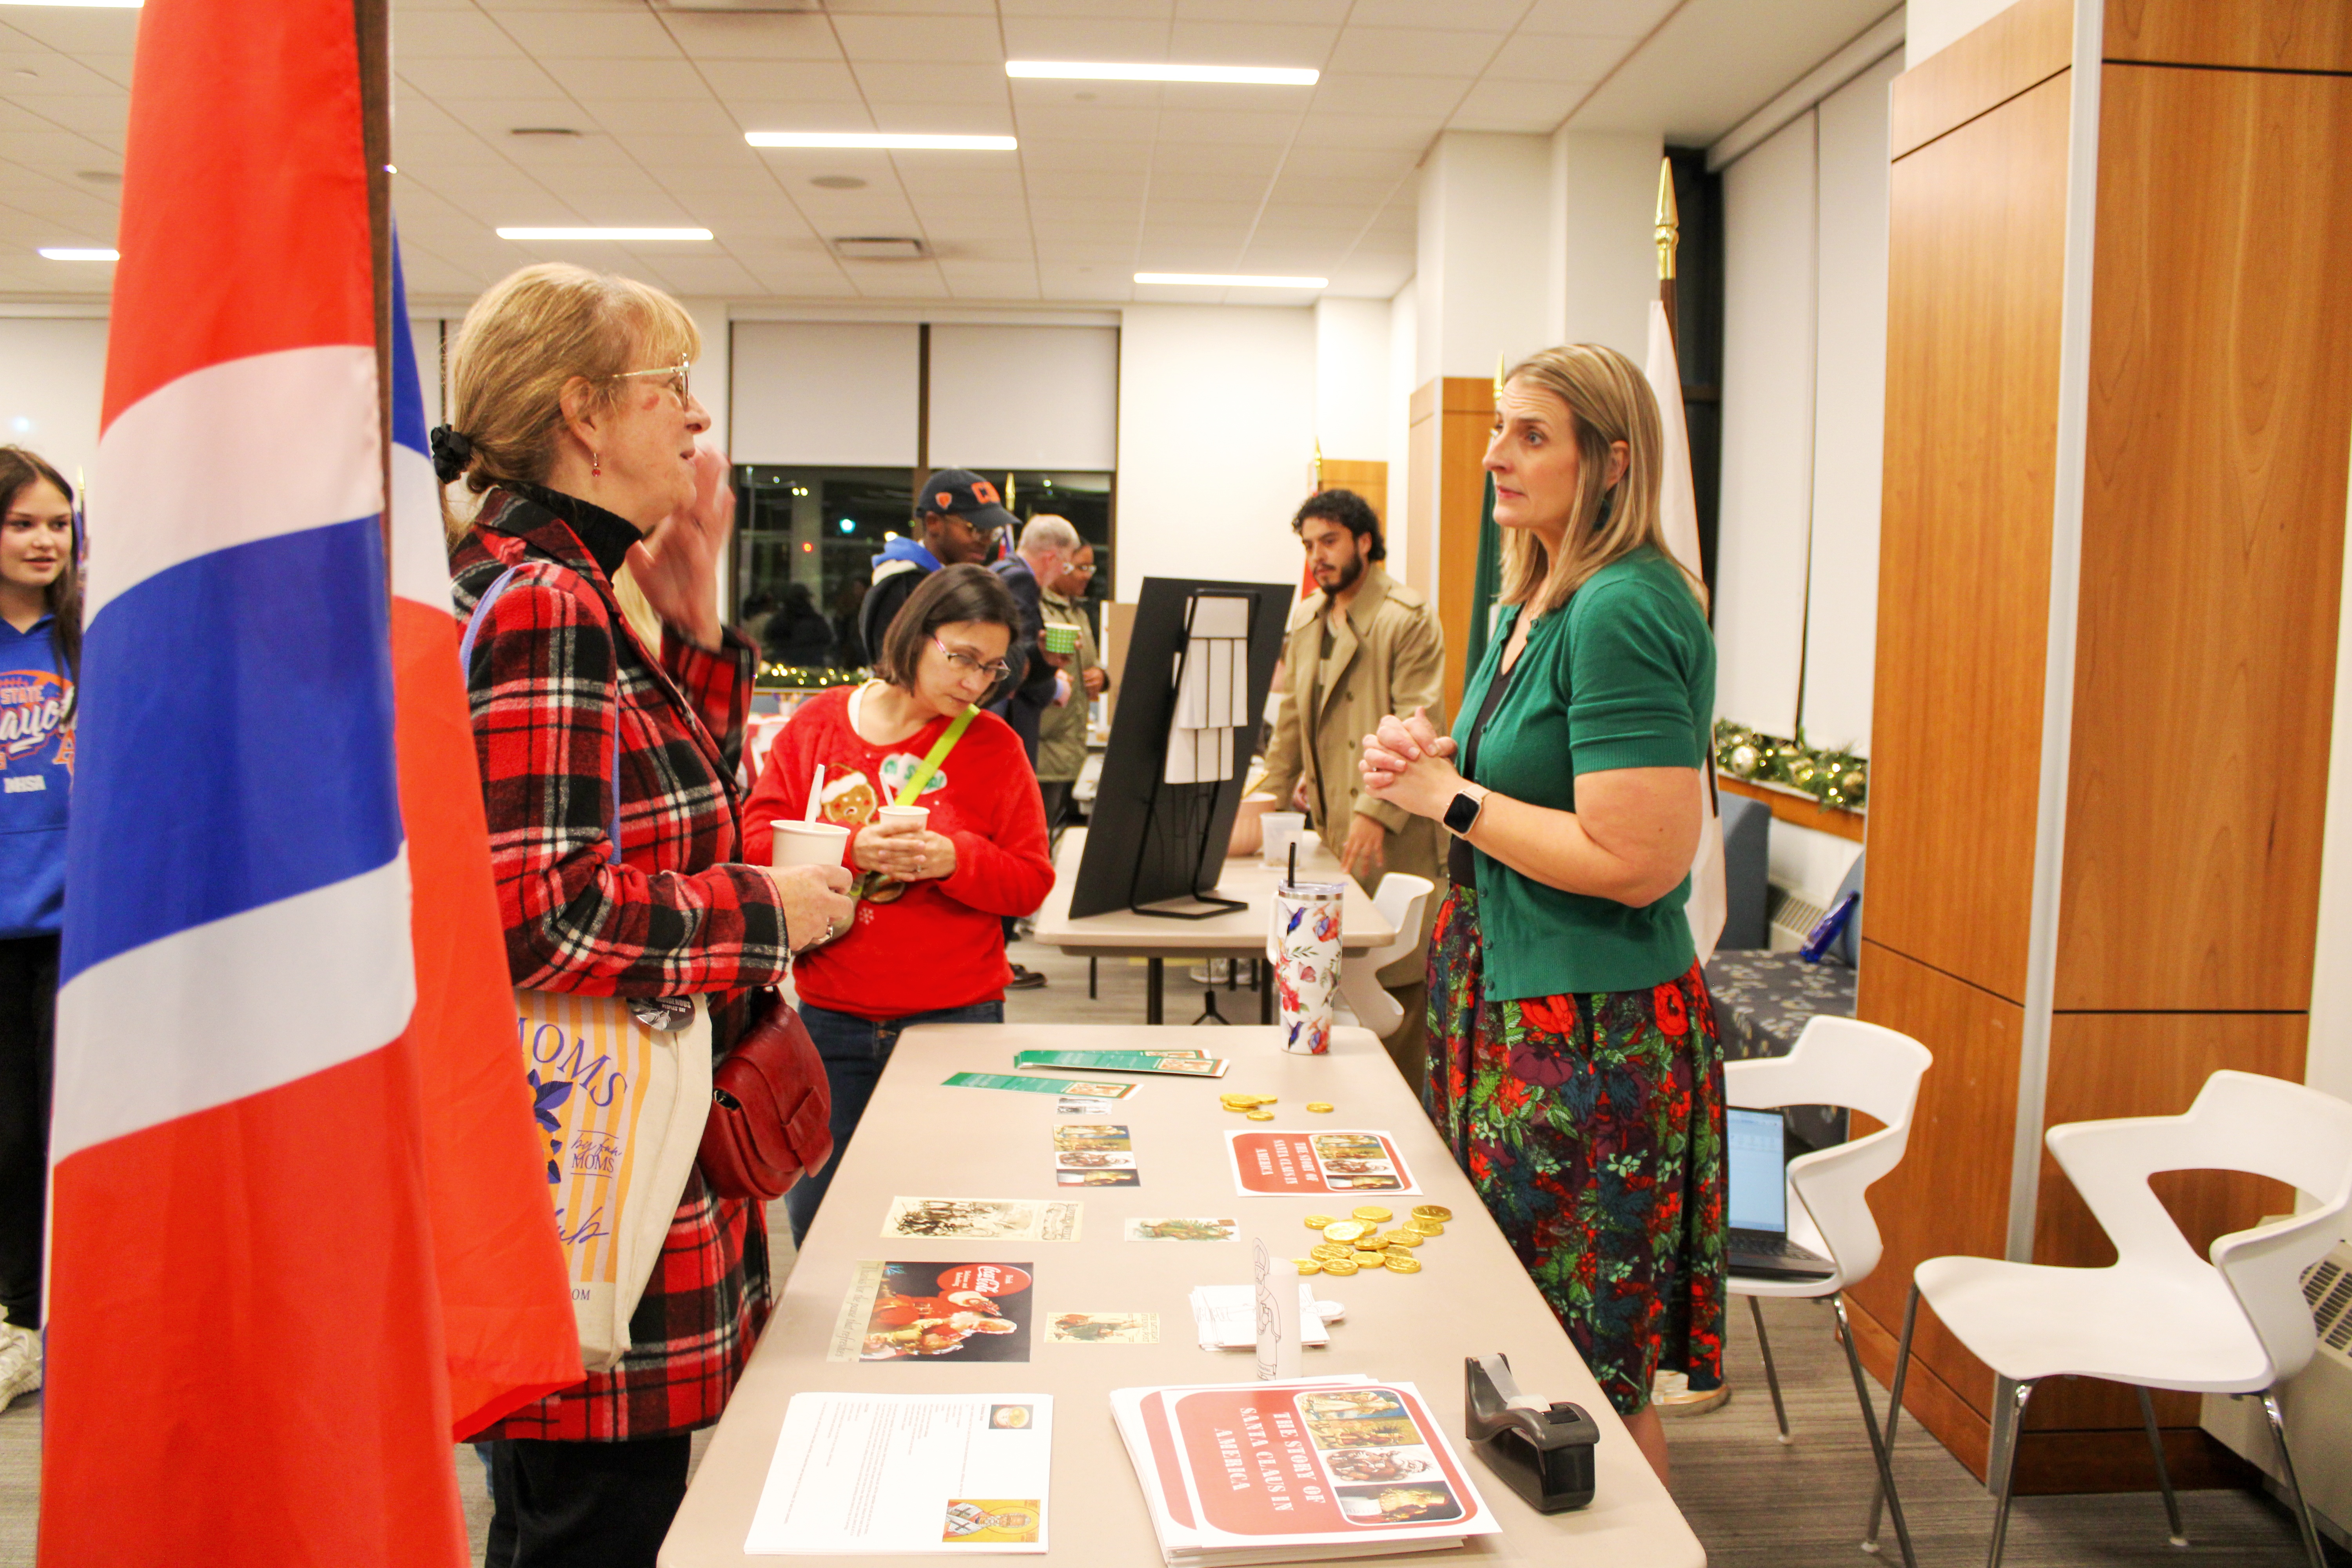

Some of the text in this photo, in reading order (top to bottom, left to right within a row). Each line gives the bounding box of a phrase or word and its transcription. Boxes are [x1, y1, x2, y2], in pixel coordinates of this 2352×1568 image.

[572, 1153, 614, 1172] MOMS
[1255, 1148, 1274, 1175] AMERICA
[1273, 1139, 1289, 1157] SANTA
[1294, 1142, 1319, 1182] THE STORY OF
[1279, 1158, 1296, 1176] CLAUS
[1214, 1428, 1250, 1491] AMERICA
[1240, 1408, 1294, 1511] SANTA CLAUS IN
[1273, 1412, 1326, 1503] THE STORY OF
